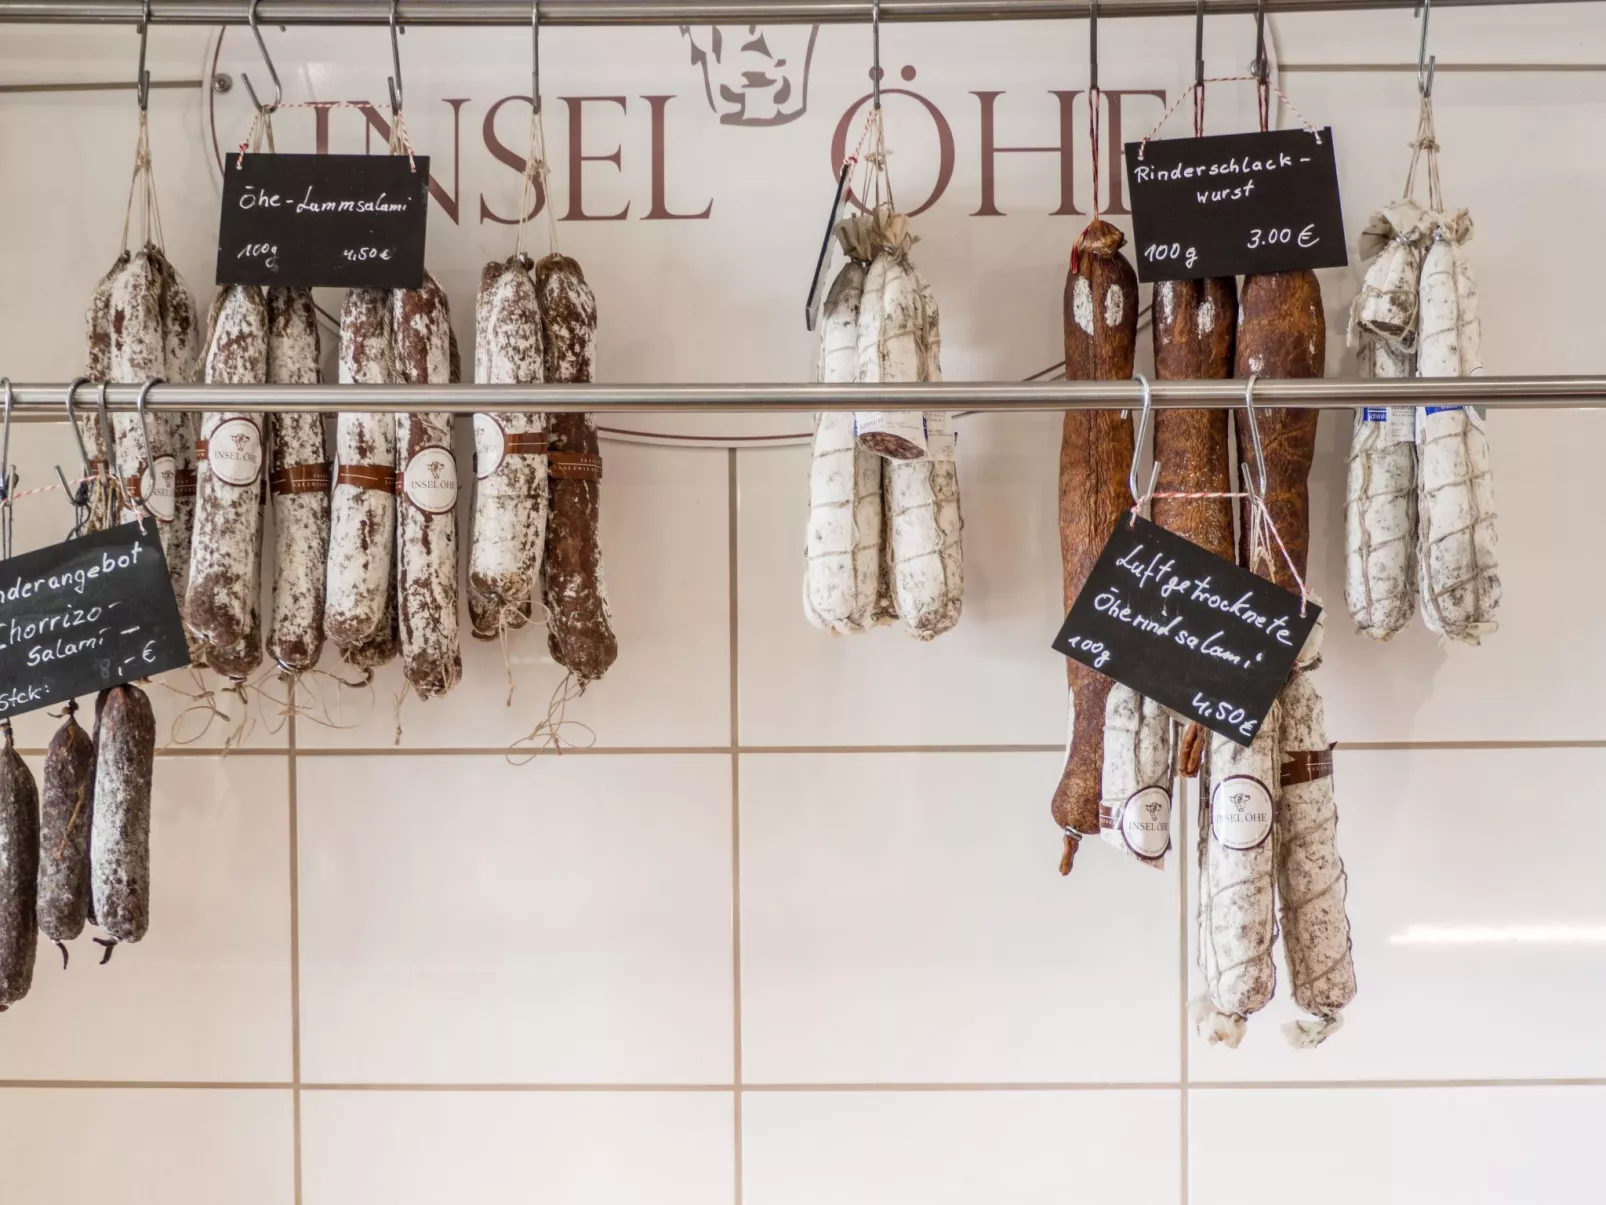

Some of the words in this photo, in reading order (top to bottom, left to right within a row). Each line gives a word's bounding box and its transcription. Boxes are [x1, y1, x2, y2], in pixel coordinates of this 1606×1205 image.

[830, 65, 1166, 218] ÖHE
[411, 480, 439, 489] INSEL
[1129, 821, 1156, 831] INSEL
